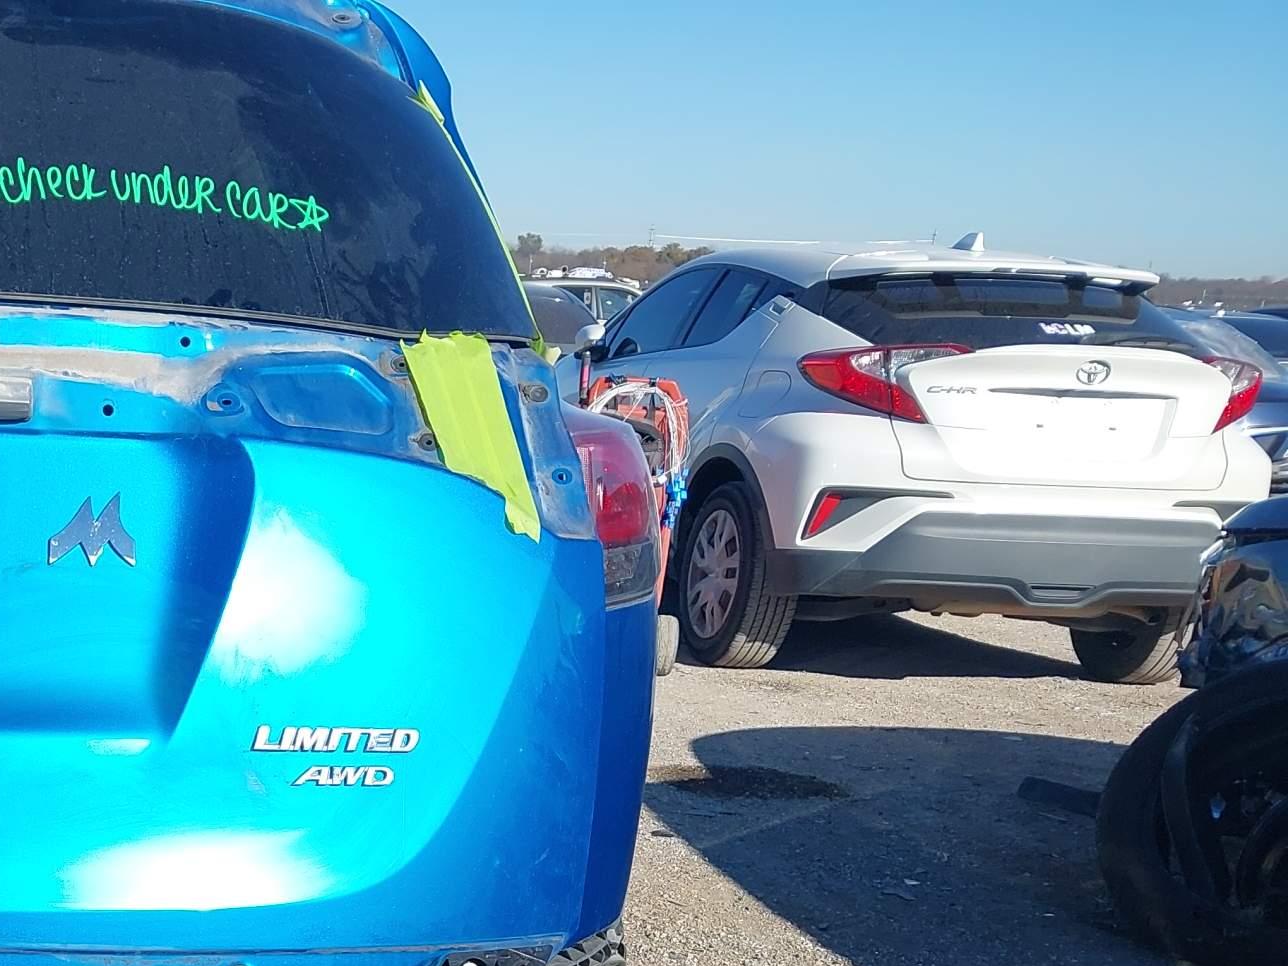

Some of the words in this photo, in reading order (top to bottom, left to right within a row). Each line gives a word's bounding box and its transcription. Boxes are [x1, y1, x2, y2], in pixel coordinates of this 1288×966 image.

[926, 385, 977, 394] C-HR
[250, 724, 420, 753] LIMITED
[290, 765, 395, 788] AWD
